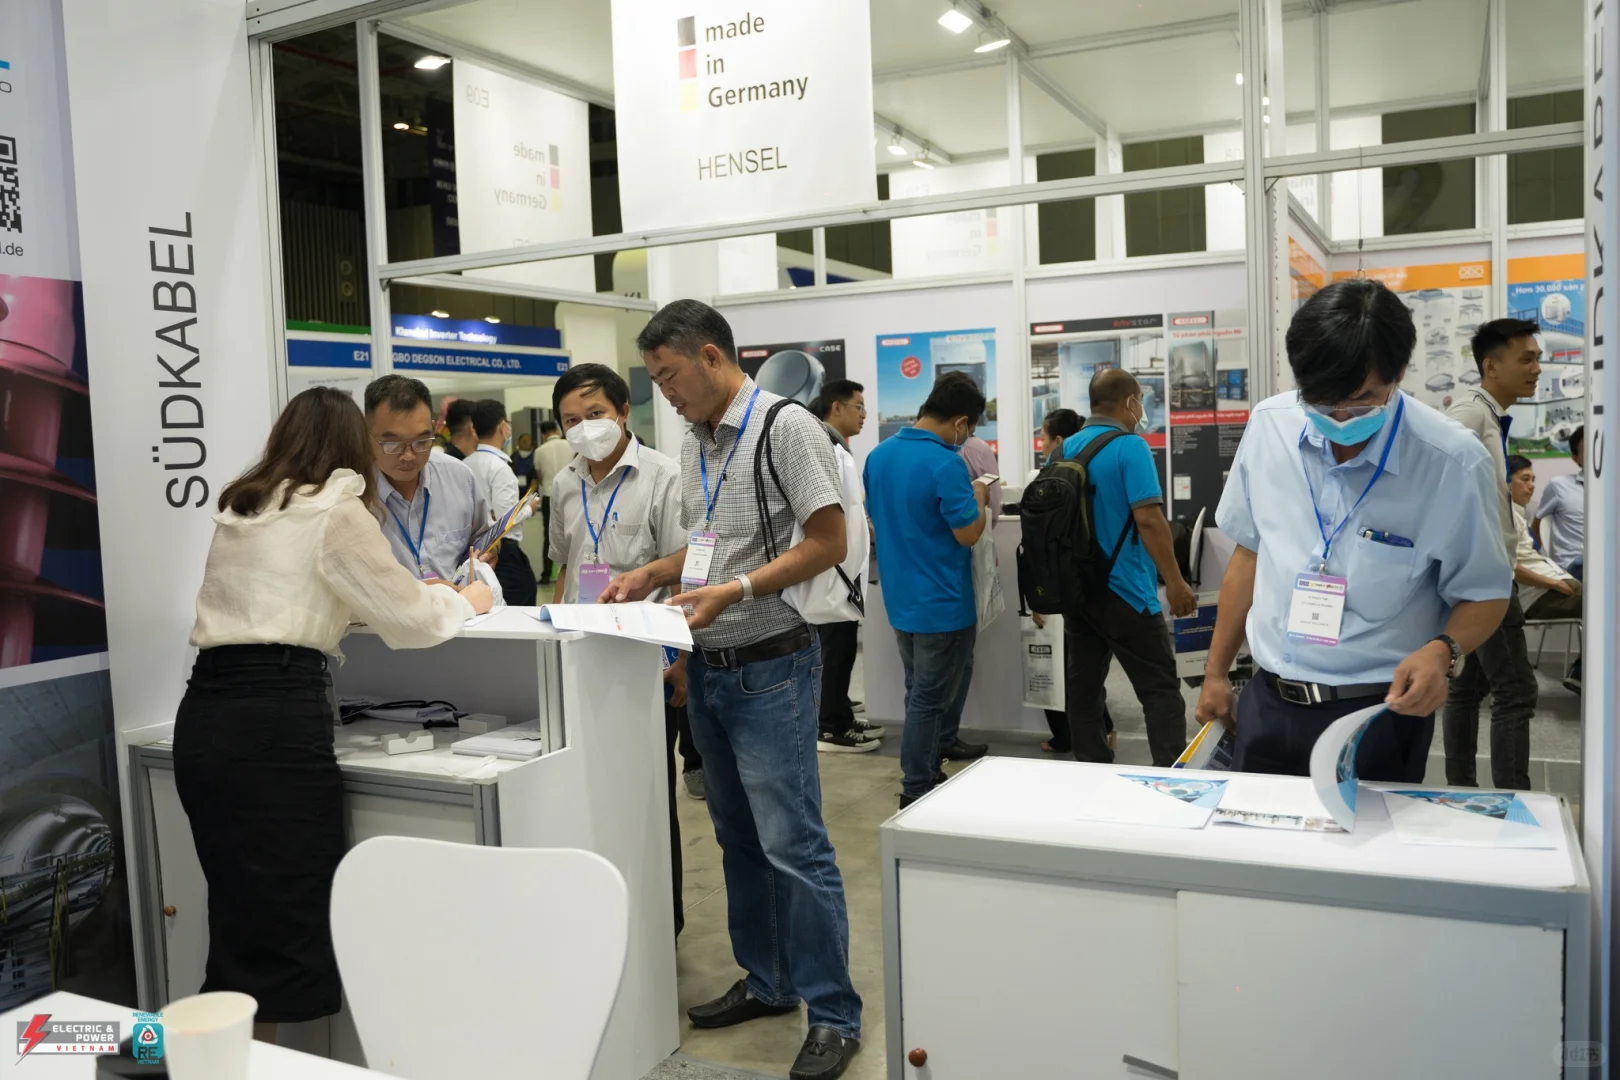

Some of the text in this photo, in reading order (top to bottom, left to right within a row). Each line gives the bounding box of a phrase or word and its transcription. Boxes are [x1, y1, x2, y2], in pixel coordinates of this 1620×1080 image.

[705, 12, 765, 43] made
[706, 54, 725, 76] in
[707, 76, 809, 108] Germany
[697, 146, 788, 181] HENSEL
[148, 211, 210, 508] SÜDKABEL
[353, 350, 369, 361] E21
[411, 353, 445, 365] DEGSON
[446, 356, 491, 368] ELECTRICAL
